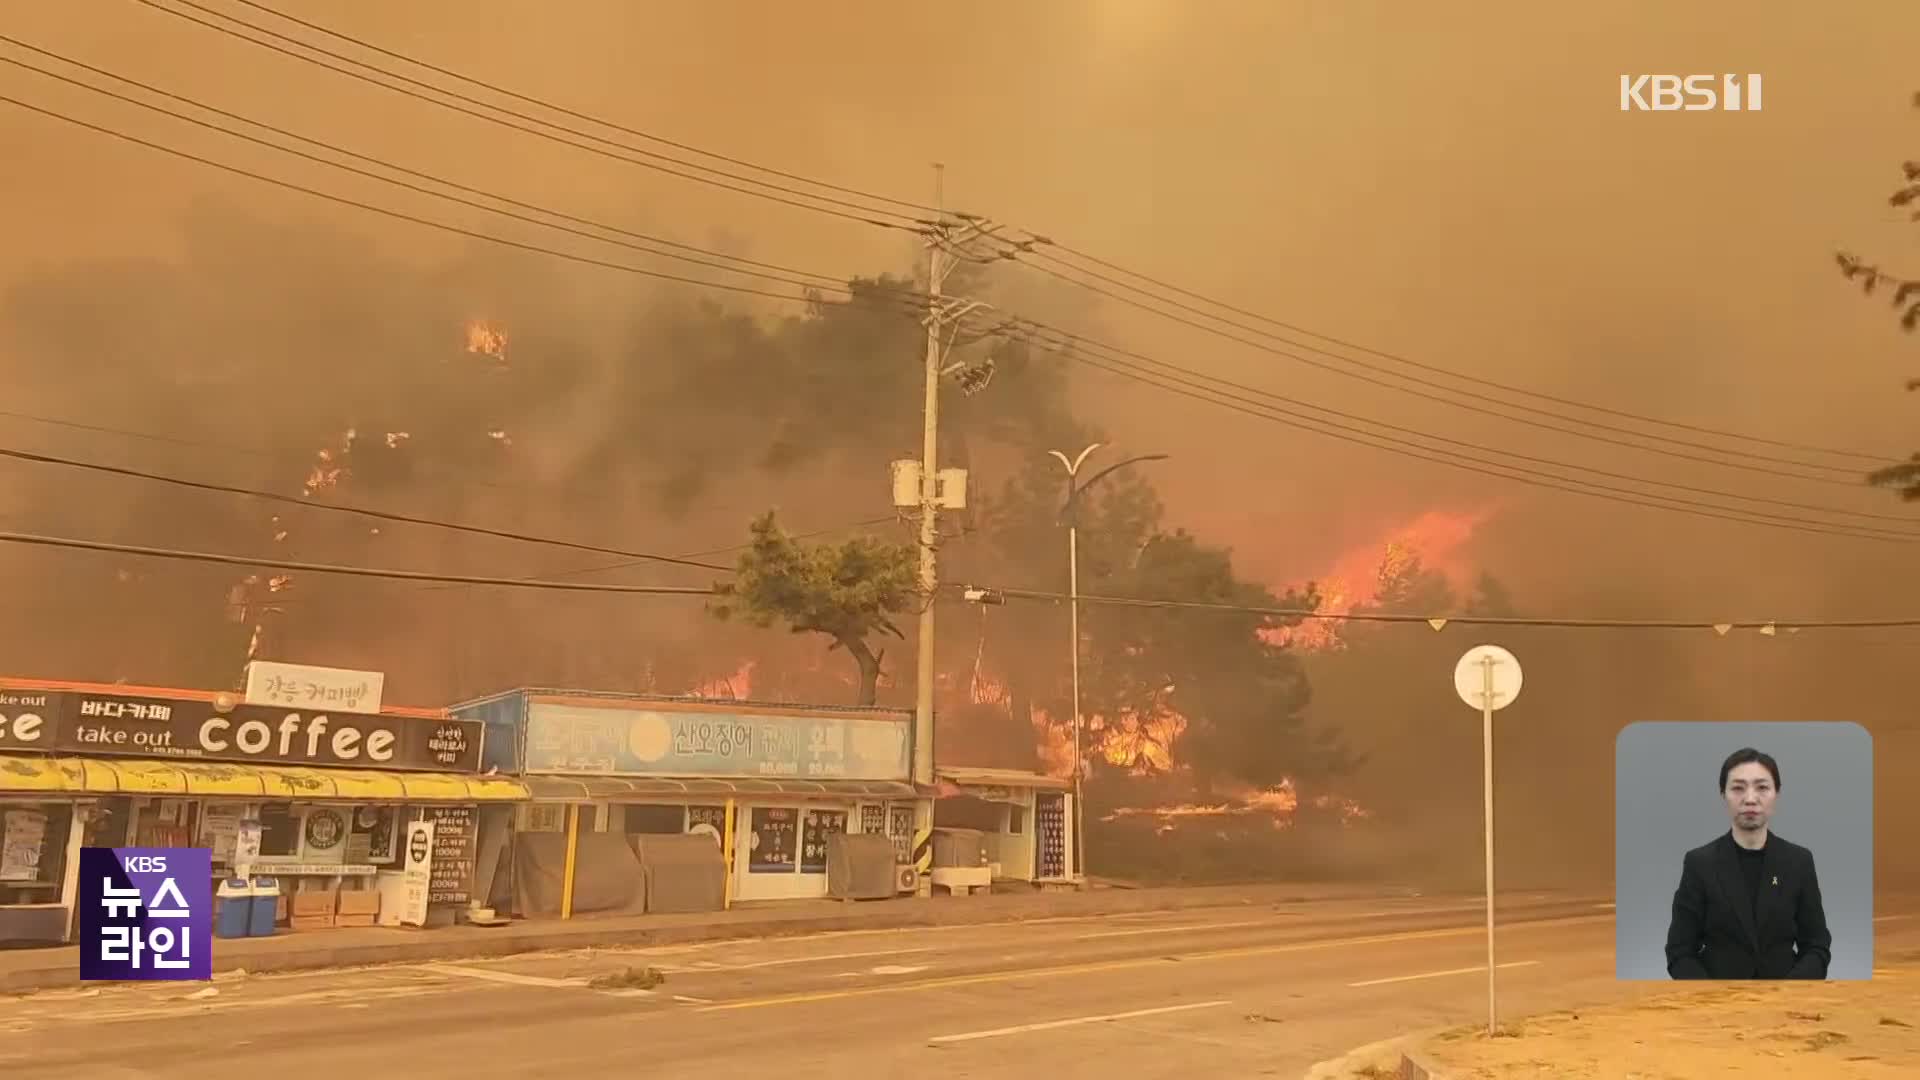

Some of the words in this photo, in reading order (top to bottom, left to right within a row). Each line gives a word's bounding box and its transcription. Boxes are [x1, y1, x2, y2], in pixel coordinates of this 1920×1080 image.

[20, 695, 46, 706] out
[265, 675, 299, 703] 강릉
[304, 682, 369, 709] 커피빵
[80, 700, 173, 721] 바다카페
[76, 725, 128, 745] take
[133, 730, 172, 747] out
[199, 713, 396, 762] coffee
